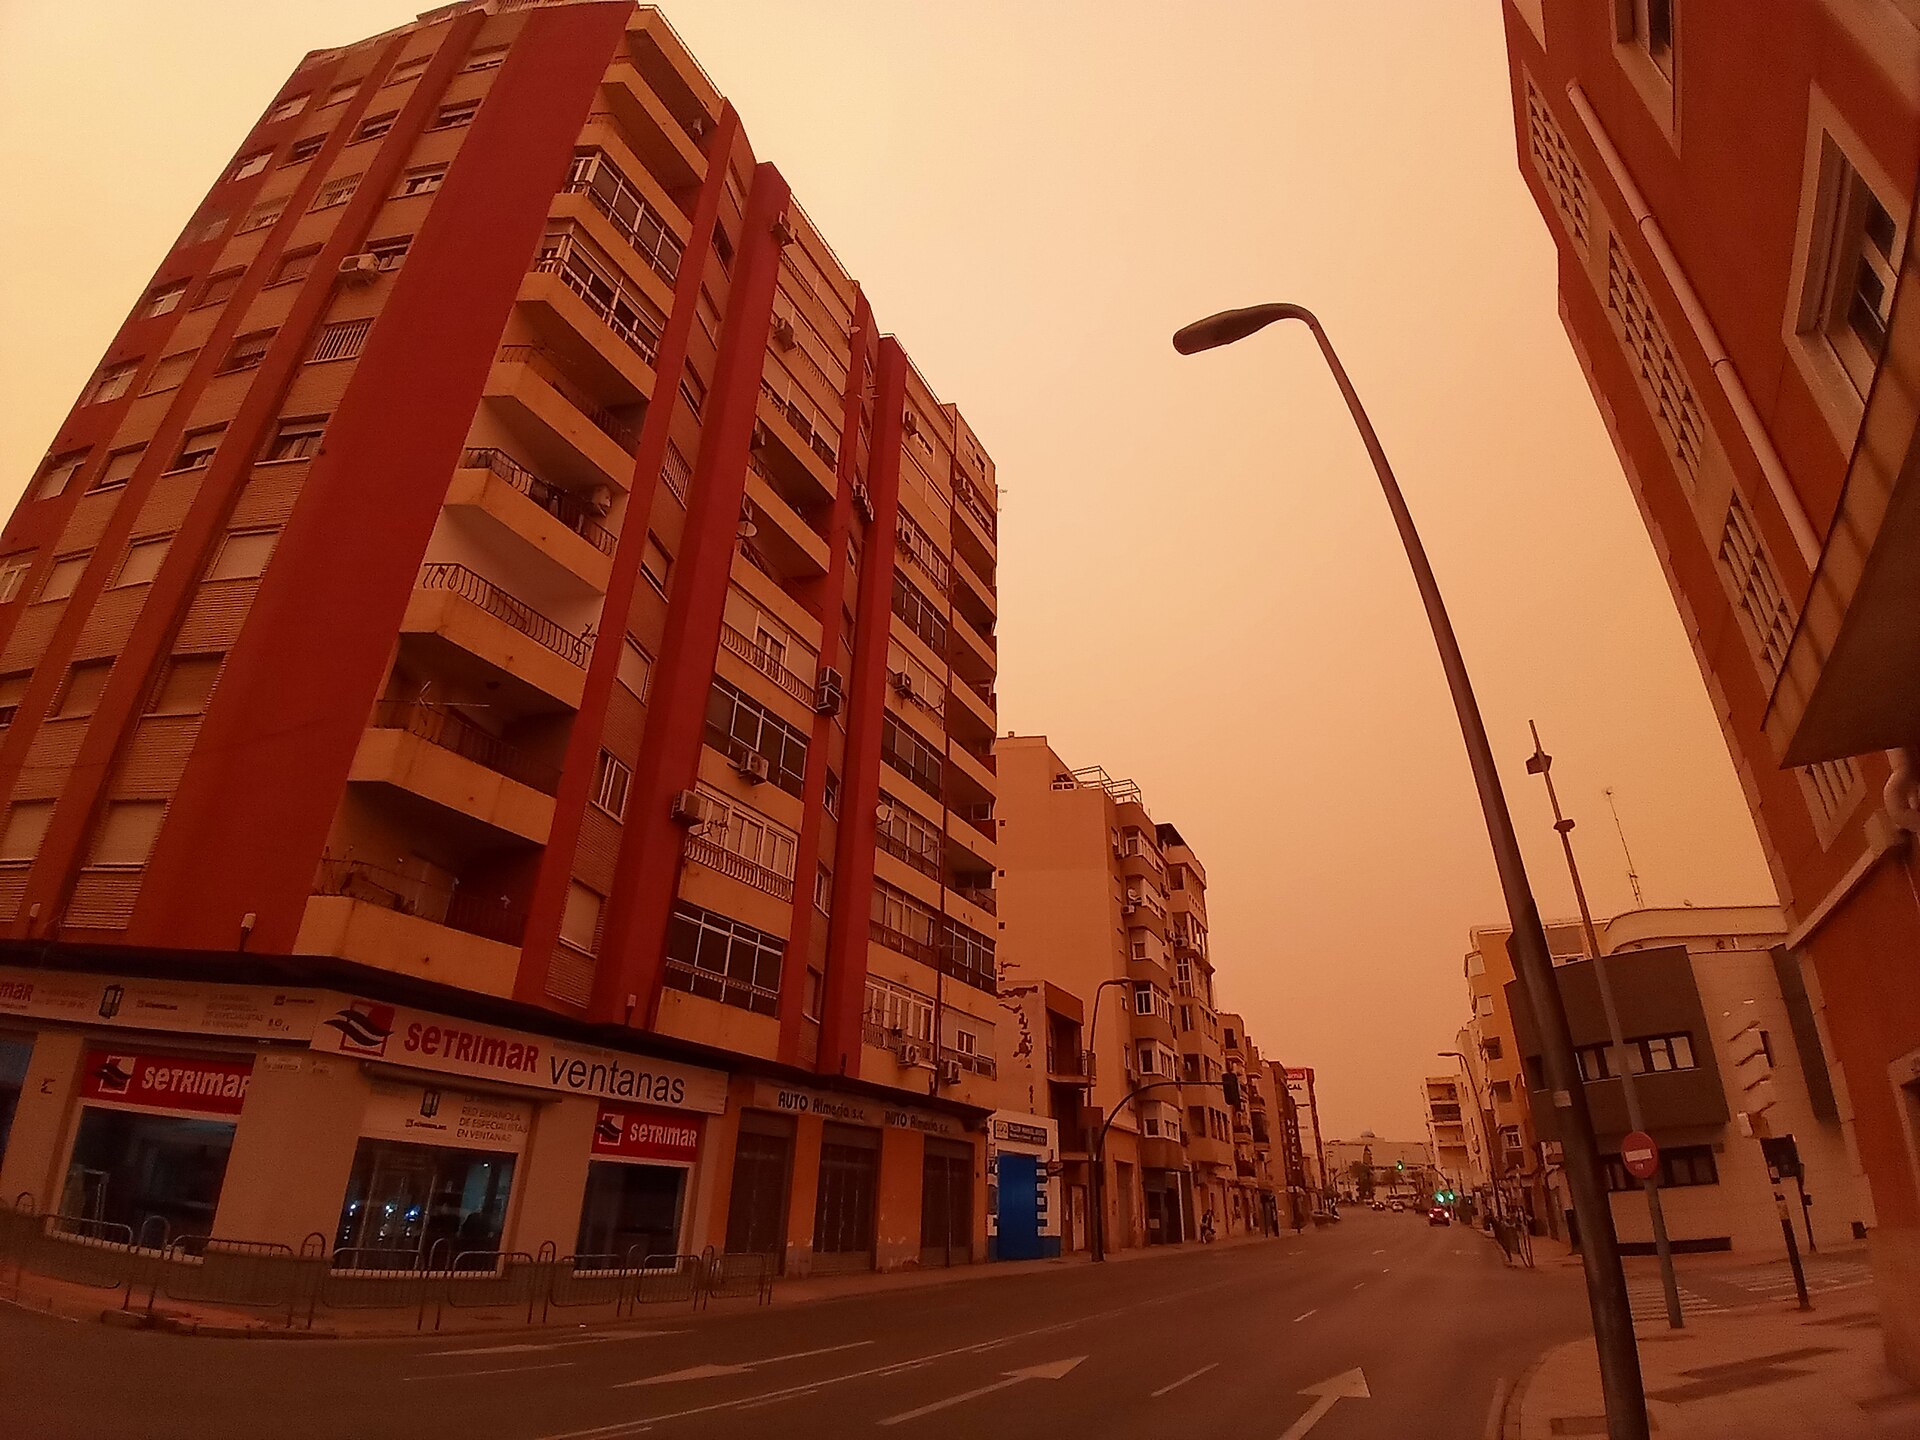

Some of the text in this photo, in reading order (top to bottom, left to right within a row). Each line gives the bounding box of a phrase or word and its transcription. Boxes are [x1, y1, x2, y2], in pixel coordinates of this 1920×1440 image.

[550, 1056, 686, 1105] ventanas
[778, 1091, 809, 1112] AUTO
[884, 1111, 908, 1128] AUTO
